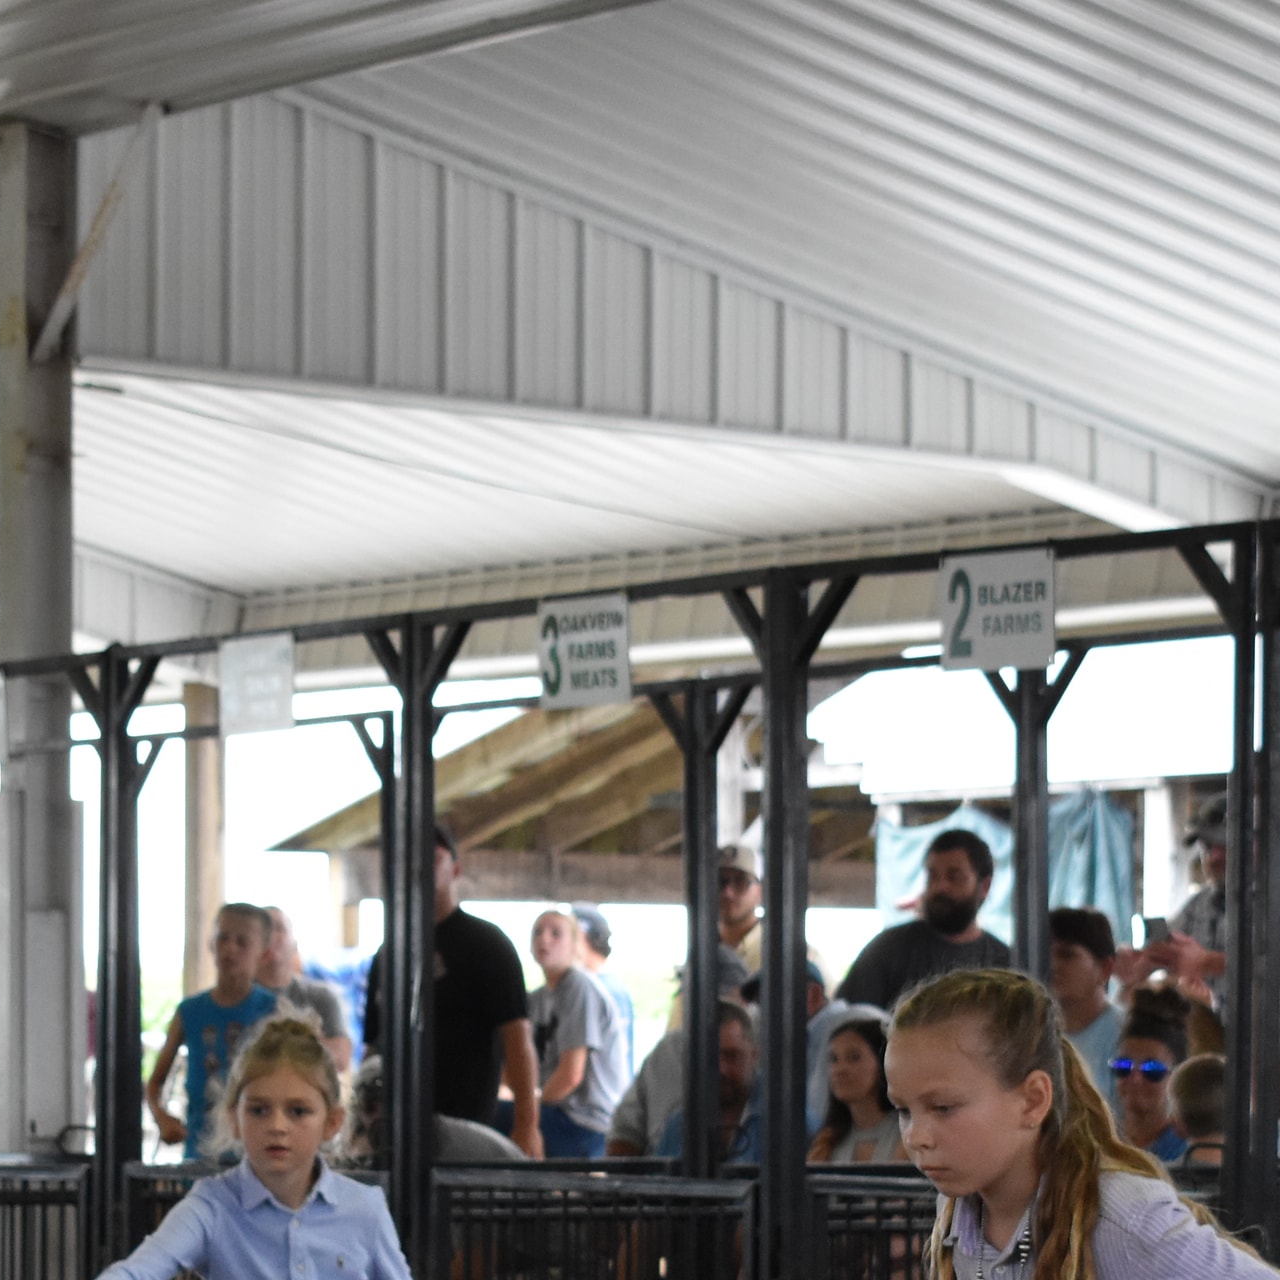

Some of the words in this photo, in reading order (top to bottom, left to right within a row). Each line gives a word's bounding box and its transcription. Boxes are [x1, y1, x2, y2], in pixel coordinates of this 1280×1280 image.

[977, 581, 1047, 605] BLAZER
[948, 567, 972, 658] 2
[982, 611, 1042, 637] FARMS
[542, 613, 562, 696] 3
[567, 640, 617, 662] FARMS
[570, 668, 618, 690] MEATS
